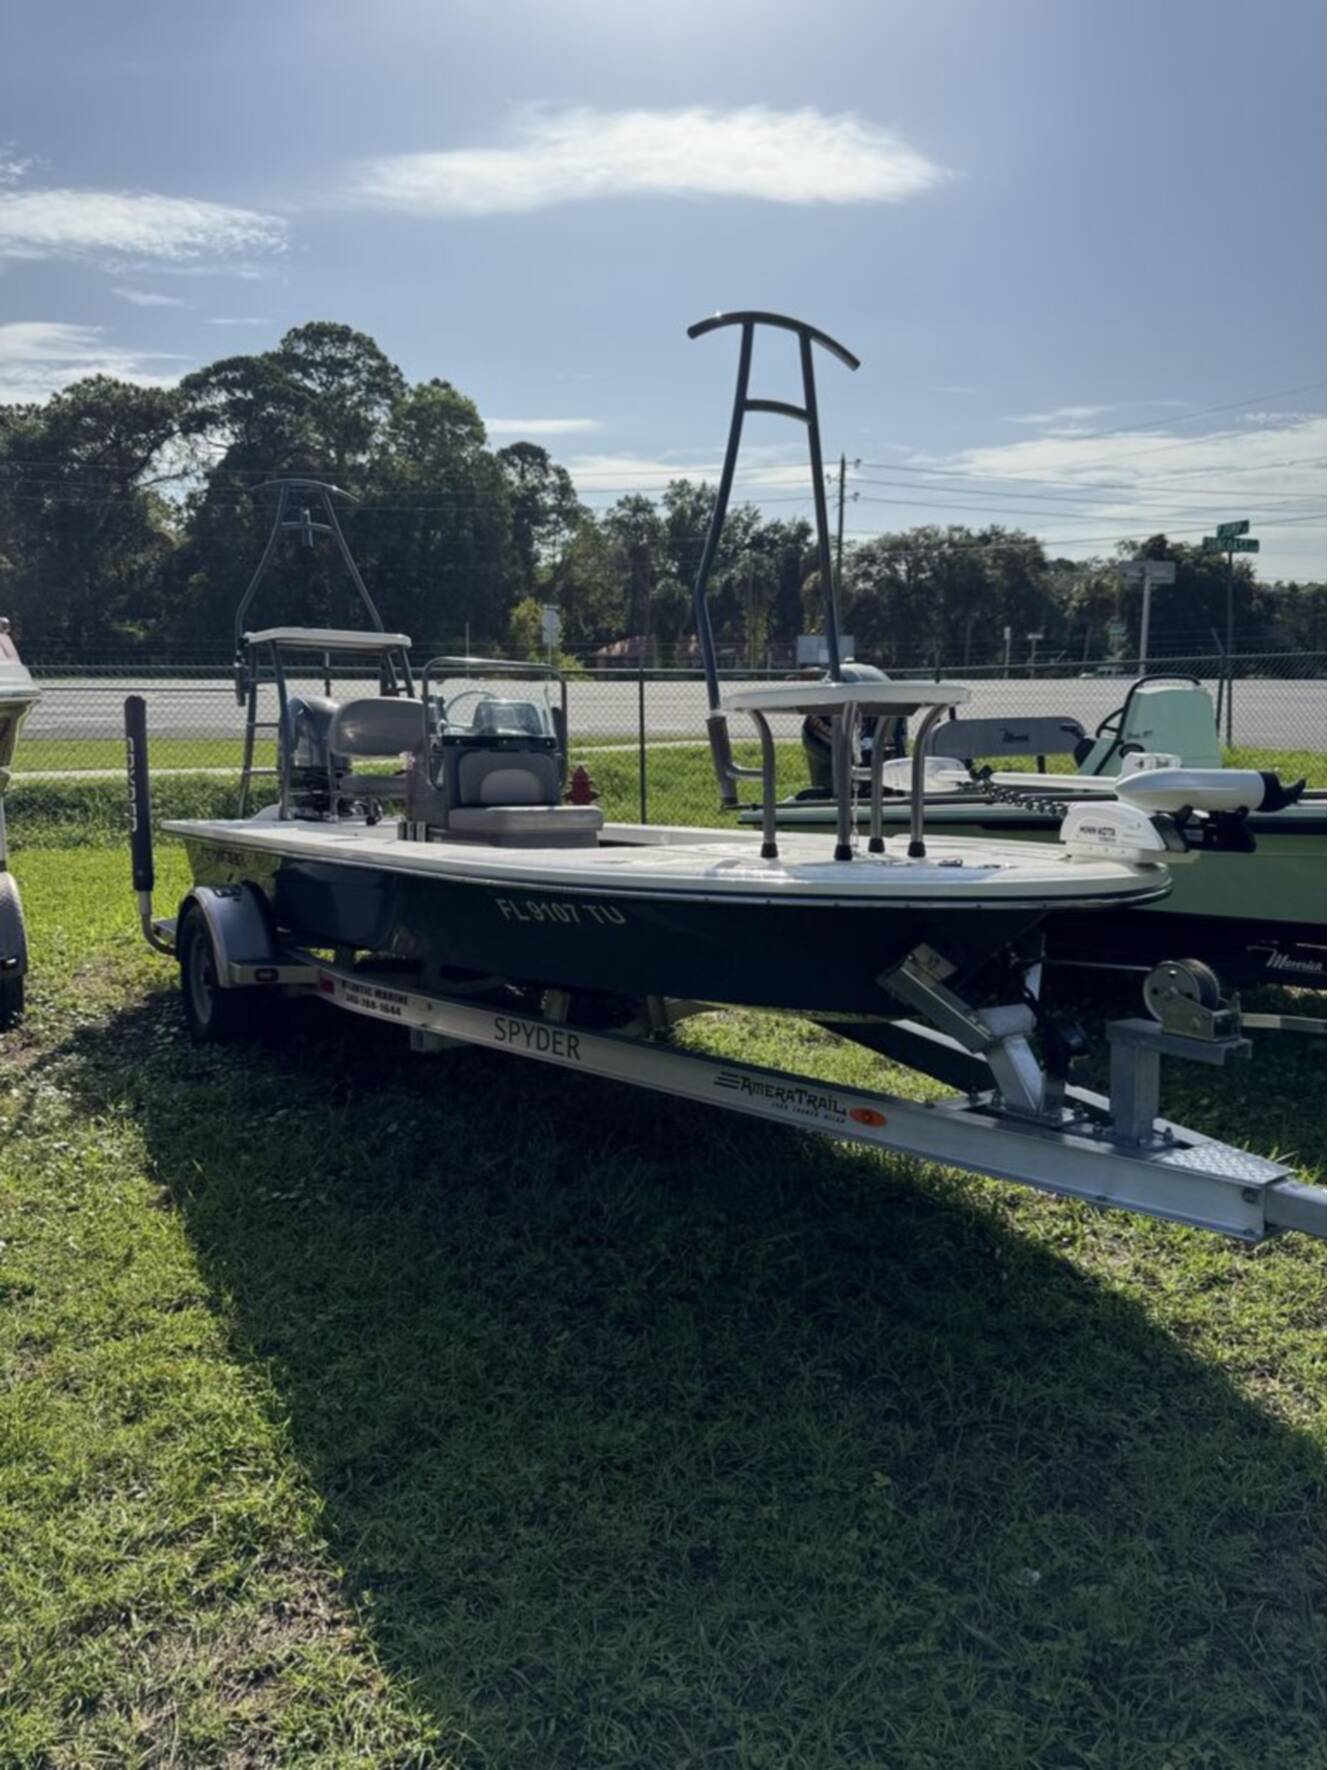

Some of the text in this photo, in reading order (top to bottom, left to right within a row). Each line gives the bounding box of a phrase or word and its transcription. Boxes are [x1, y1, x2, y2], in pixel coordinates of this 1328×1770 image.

[496, 898, 626, 924] FL 9107 TU
[494, 1016, 581, 1061] SPYDER
